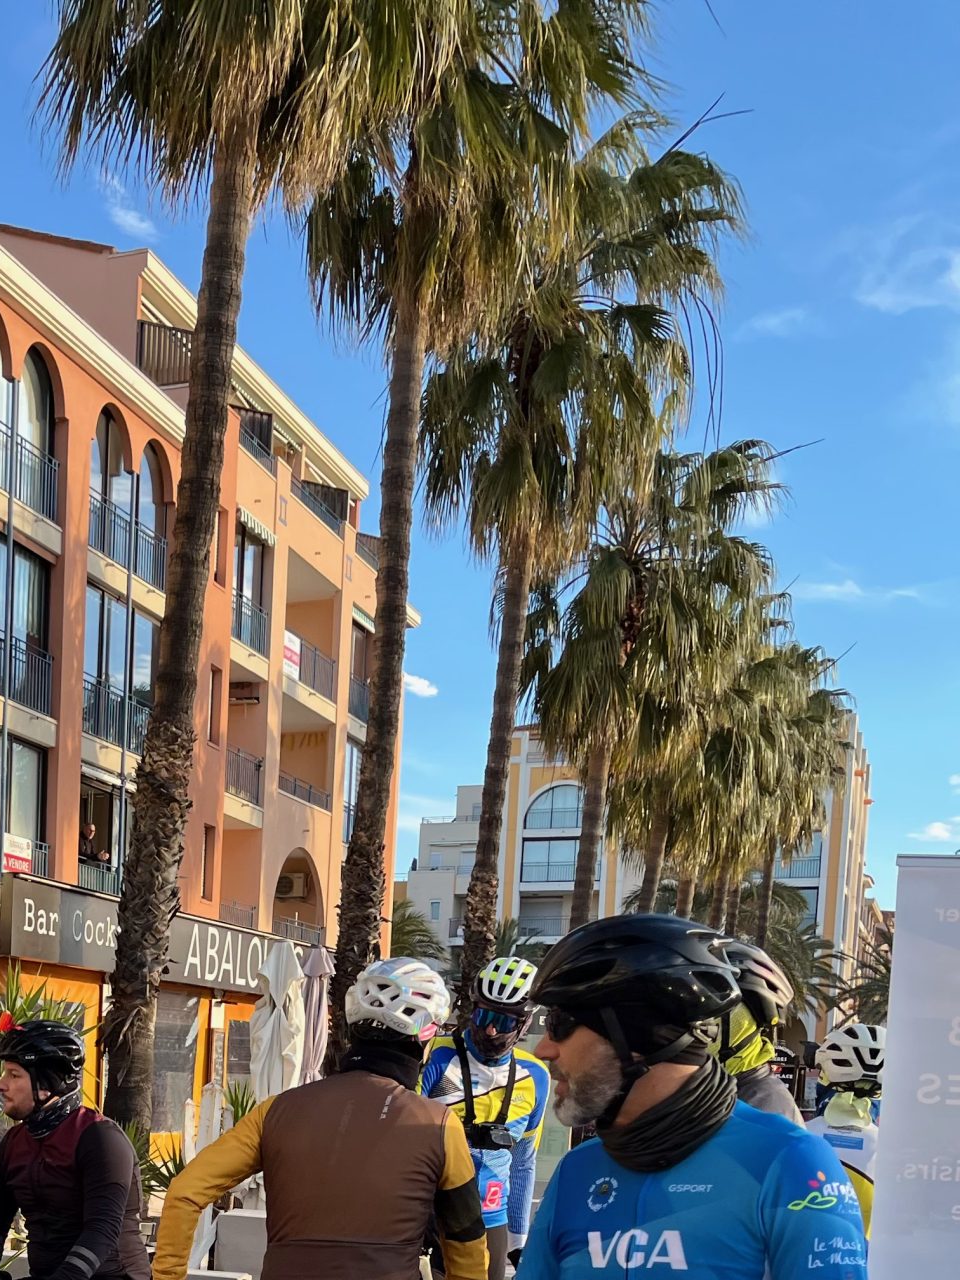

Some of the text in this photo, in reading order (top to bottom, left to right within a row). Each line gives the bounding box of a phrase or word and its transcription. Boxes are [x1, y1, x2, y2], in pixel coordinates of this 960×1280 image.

[8, 857, 30, 872] VENDRE
[23, 898, 122, 947] Bar Cock
[667, 1183, 714, 1194] GSPORT
[587, 1228, 689, 1271] VCA
